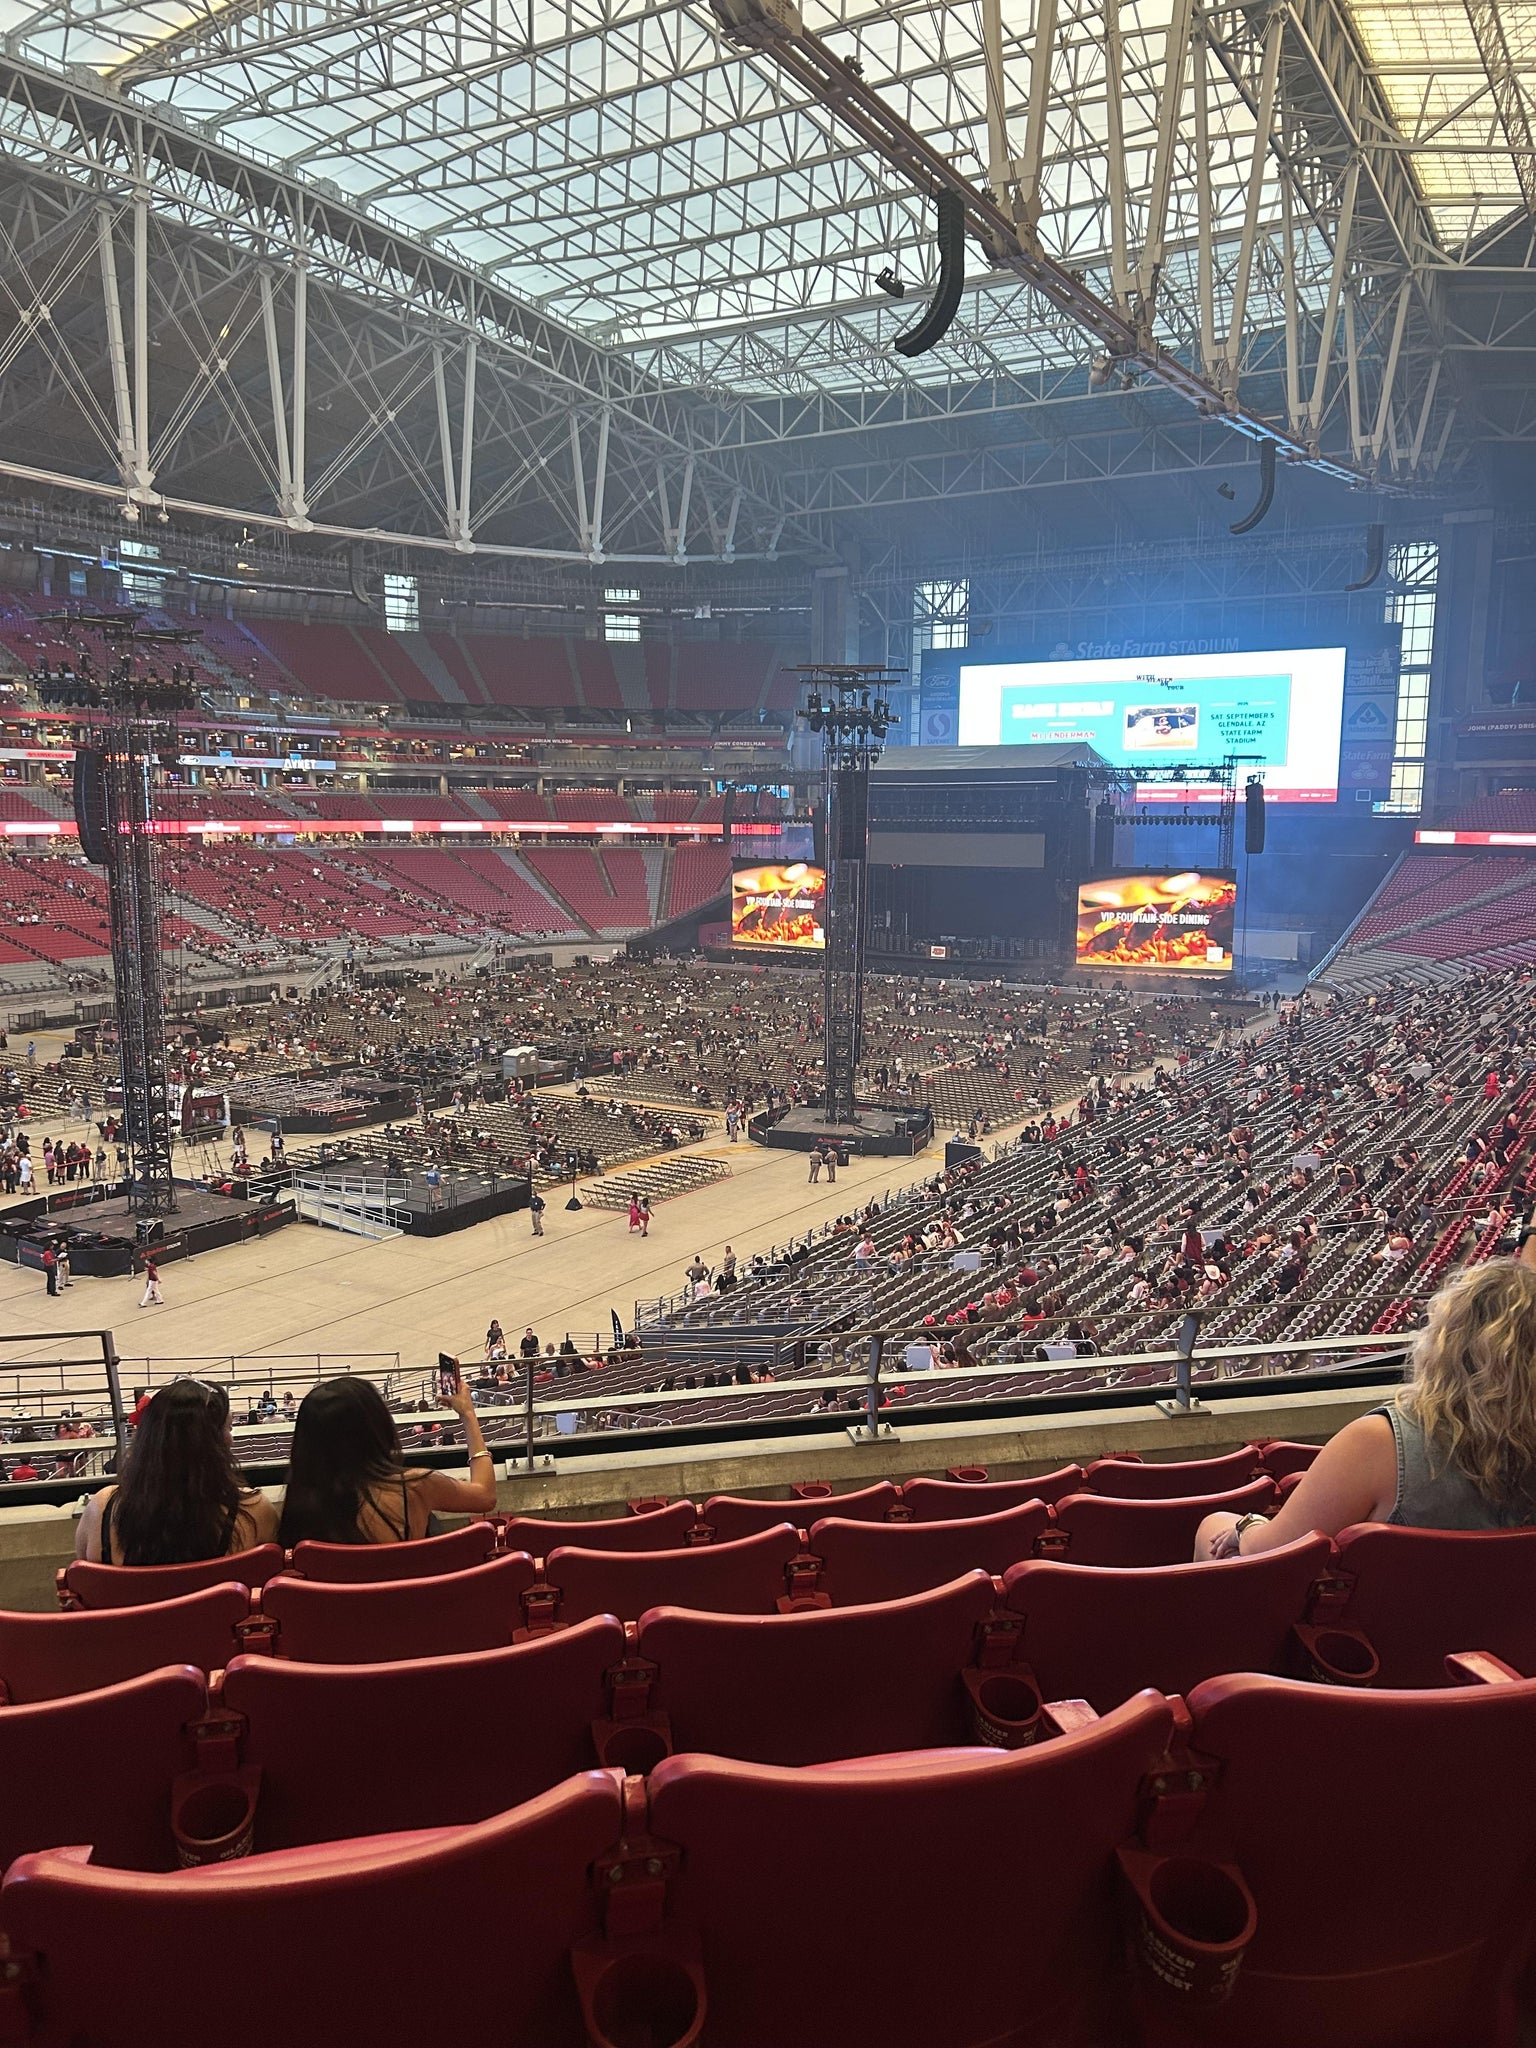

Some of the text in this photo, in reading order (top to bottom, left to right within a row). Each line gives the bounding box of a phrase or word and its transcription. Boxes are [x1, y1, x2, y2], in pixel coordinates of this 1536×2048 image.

[1075, 637, 1240, 660] StateFarm STADIUM
[1226, 712, 1269, 720] SEPTEMBER
[1487, 723, 1517, 731] (PADDY)
[1044, 731, 1096, 739] LENDERMAN
[1220, 729, 1242, 737] STATE
[1342, 750, 1391, 761] StateFarm
[746, 896, 756, 905] VIP
[1100, 911, 1210, 925] VIP FOUNTAIN-SIDE DINING
